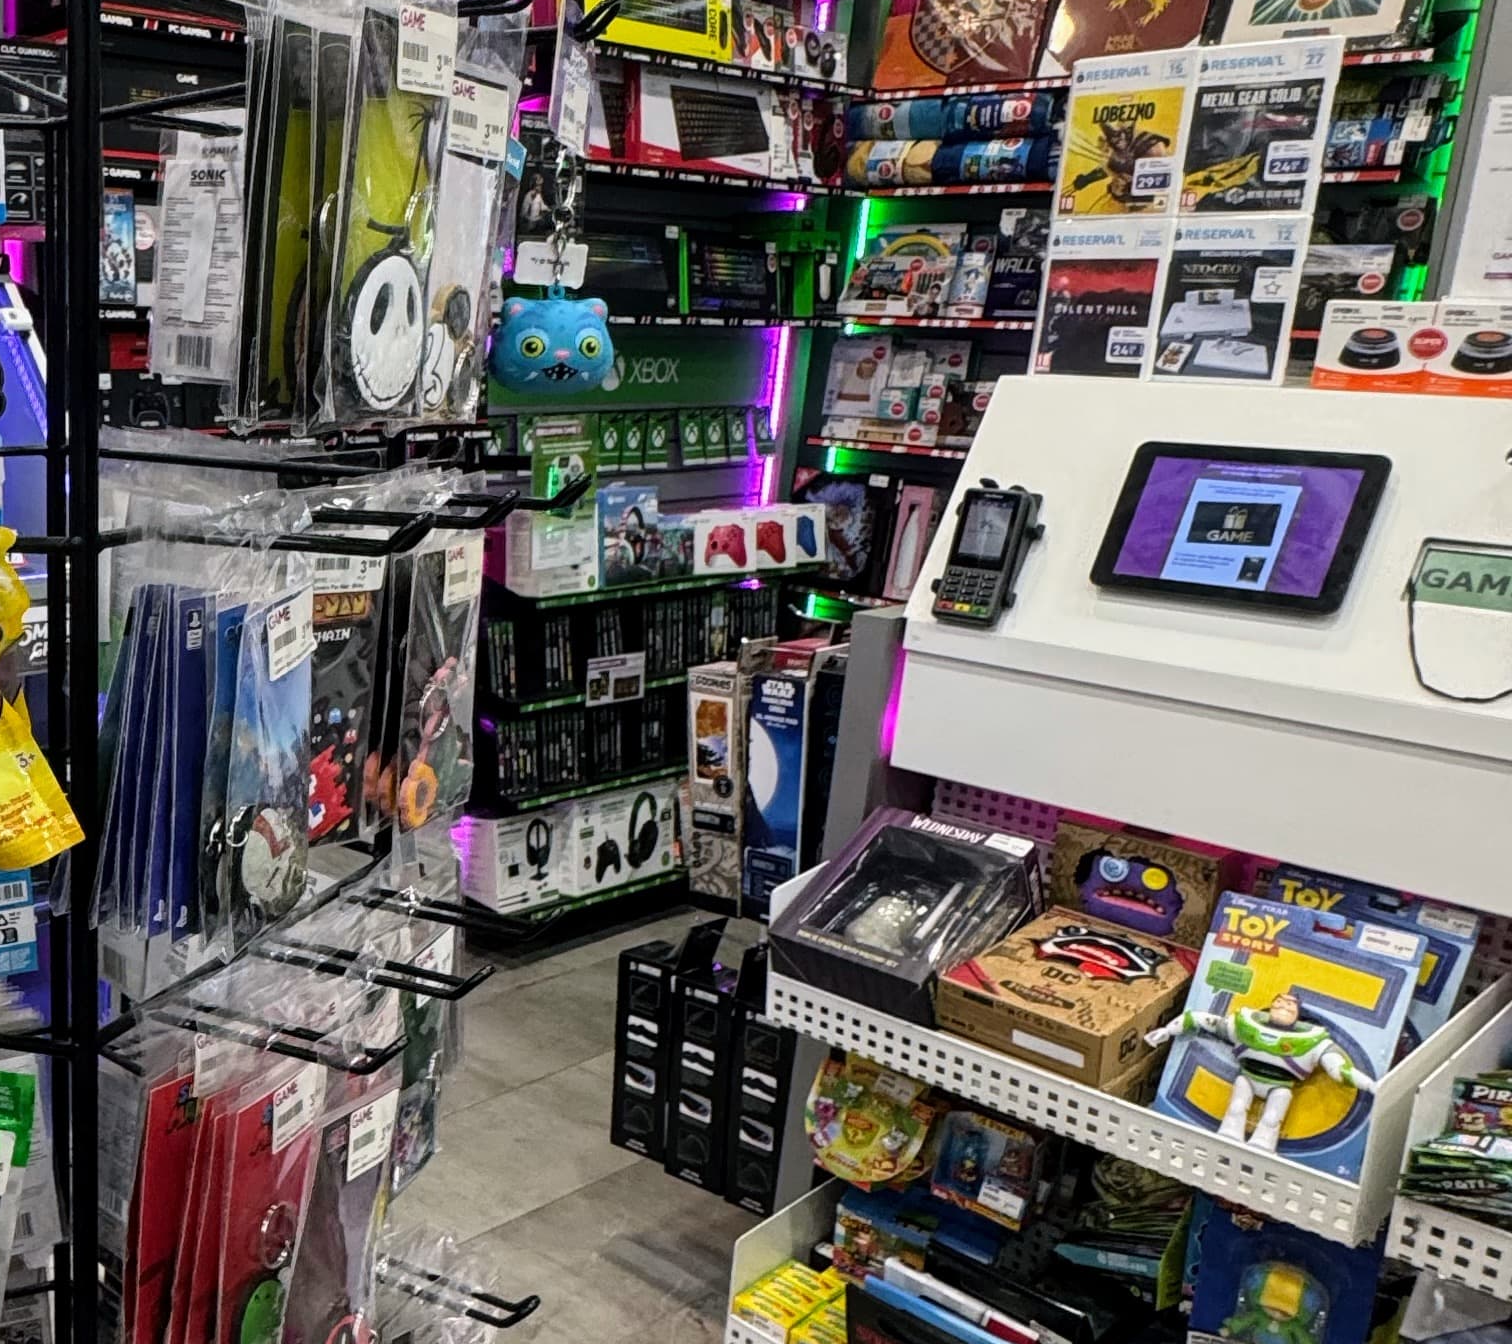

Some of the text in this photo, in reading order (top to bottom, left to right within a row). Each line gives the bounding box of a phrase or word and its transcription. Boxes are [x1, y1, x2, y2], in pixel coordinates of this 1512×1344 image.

[400, 7, 426, 33] GAME
[451, 78, 477, 102] GAME
[1200, 86, 1302, 110] METAL GEAR SOLID
[190, 169, 228, 182] SONIC
[994, 256, 1036, 274] WALL
[1054, 302, 1138, 317] SILENT HILL
[628, 356, 680, 384] XBOX
[1206, 529, 1255, 544] GAME
[1420, 567, 1512, 598] GAM
[268, 605, 292, 631] GAME
[910, 814, 985, 847] WEDNESDAY
[1222, 907, 1290, 941] TOY
[1214, 932, 1281, 956] STORY
[274, 1080, 300, 1108] GAME
[350, 1105, 375, 1130] GAME
